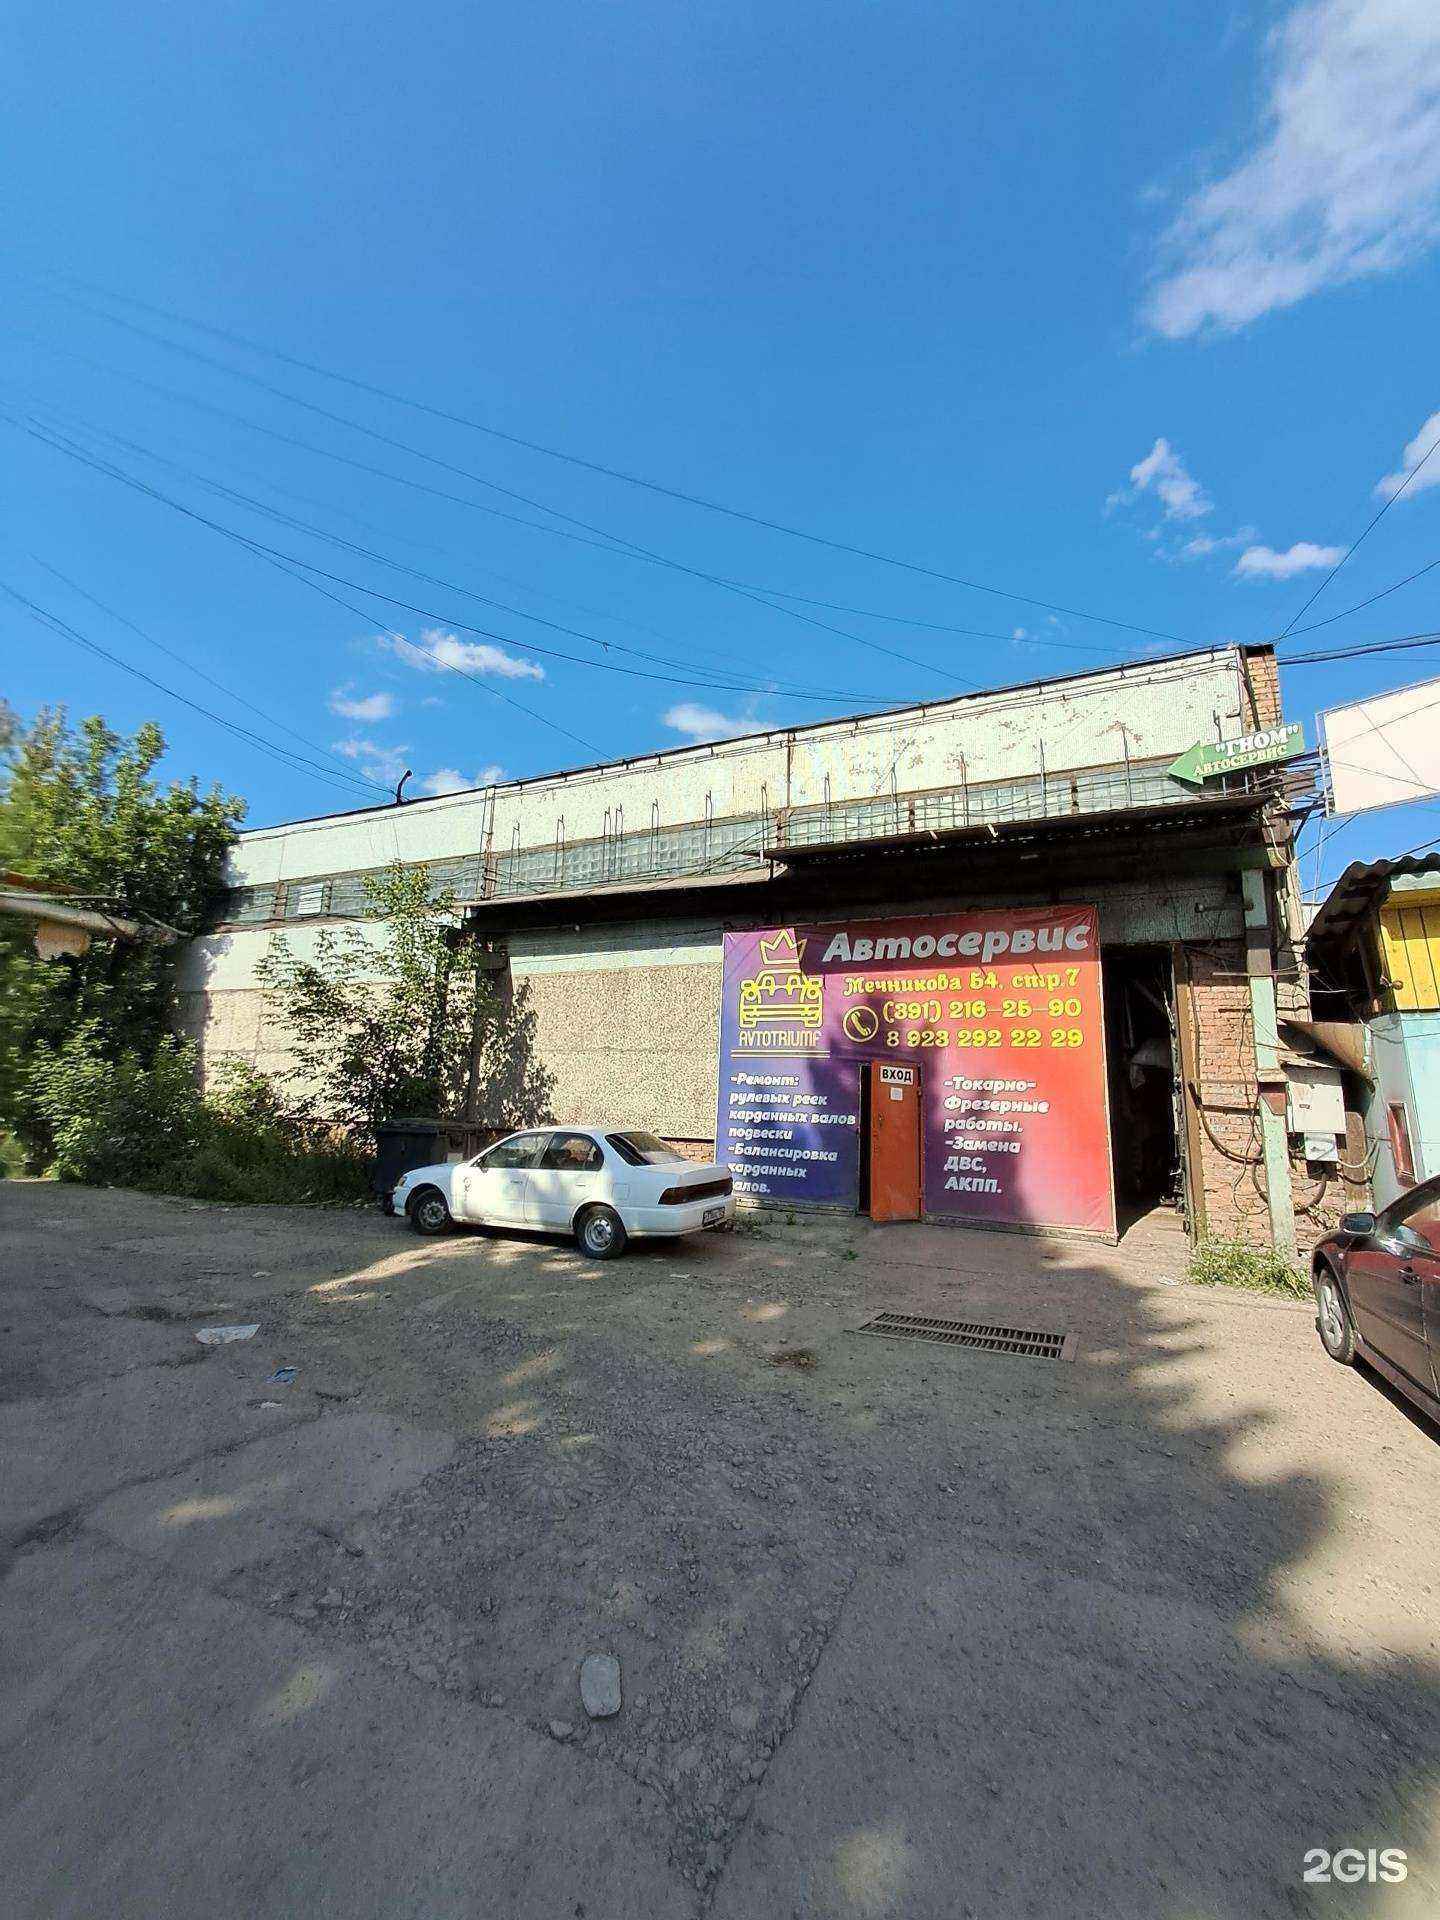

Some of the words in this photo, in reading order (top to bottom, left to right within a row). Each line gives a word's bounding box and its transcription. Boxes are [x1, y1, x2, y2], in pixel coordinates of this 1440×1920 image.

[822, 925, 1091, 963] Автосервис
[843, 973, 963, 996] Мечникова
[883, 1000, 942, 1024] (391)
[886, 1030, 900, 1047] 8
[907, 1030, 950, 1048] 923
[957, 1029, 1002, 1048] 292
[1010, 1029, 1042, 1048] 22
[1050, 1028, 1084, 1048] 29
[882, 1069, 912, 1082] ВХОД
[729, 1092, 791, 1105] рулевых
[944, 1095, 1050, 1115] Фрезерные
[729, 1109, 808, 1123] карданных
[810, 1113, 856, 1126] валов
[944, 1116, 1024, 1133] работы.
[728, 1127, 793, 1140] подвески
[944, 1136, 1021, 1154] -Замена
[943, 1156, 987, 1173] ДВС,
[732, 1181, 771, 1194] алов.
[944, 1176, 1002, 1194] АКПП.
